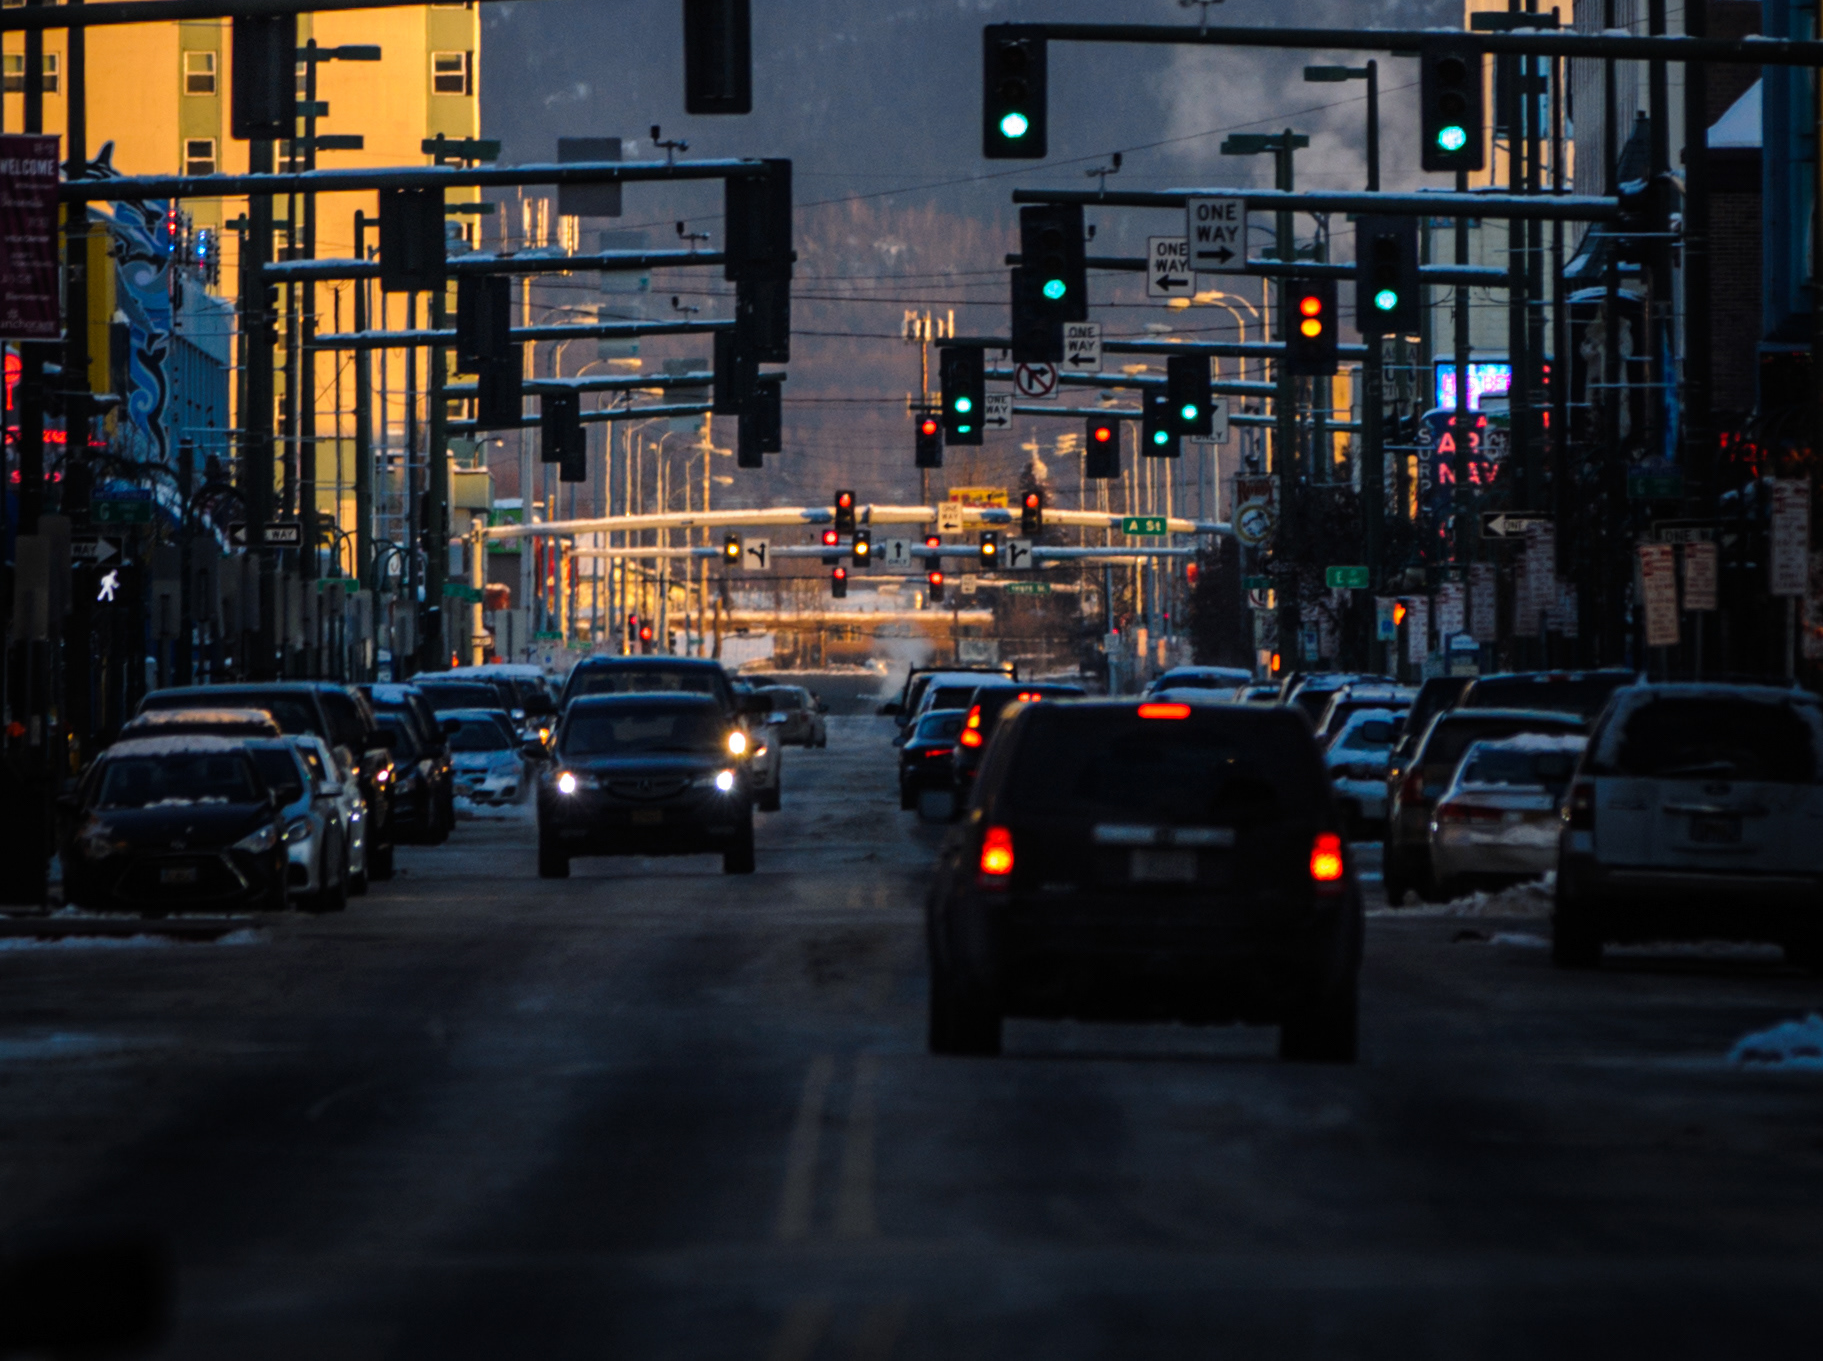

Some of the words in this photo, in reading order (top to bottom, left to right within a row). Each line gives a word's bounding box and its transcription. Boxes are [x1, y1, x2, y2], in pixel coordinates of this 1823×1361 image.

[0, 158, 55, 176] WELCOME
[1197, 204, 1238, 222] ONE
[1196, 225, 1239, 243] WAY
[1156, 242, 1188, 256] ONE
[1155, 259, 1188, 273] WAY
[1068, 327, 1096, 339] ONE
[1067, 340, 1097, 352] WAY
[987, 395, 1007, 404] ONE
[986, 405, 1008, 414] WAY
[1128, 520, 1138, 531] A
[1145, 520, 1162, 532] St
[272, 530, 294, 539] WAY
